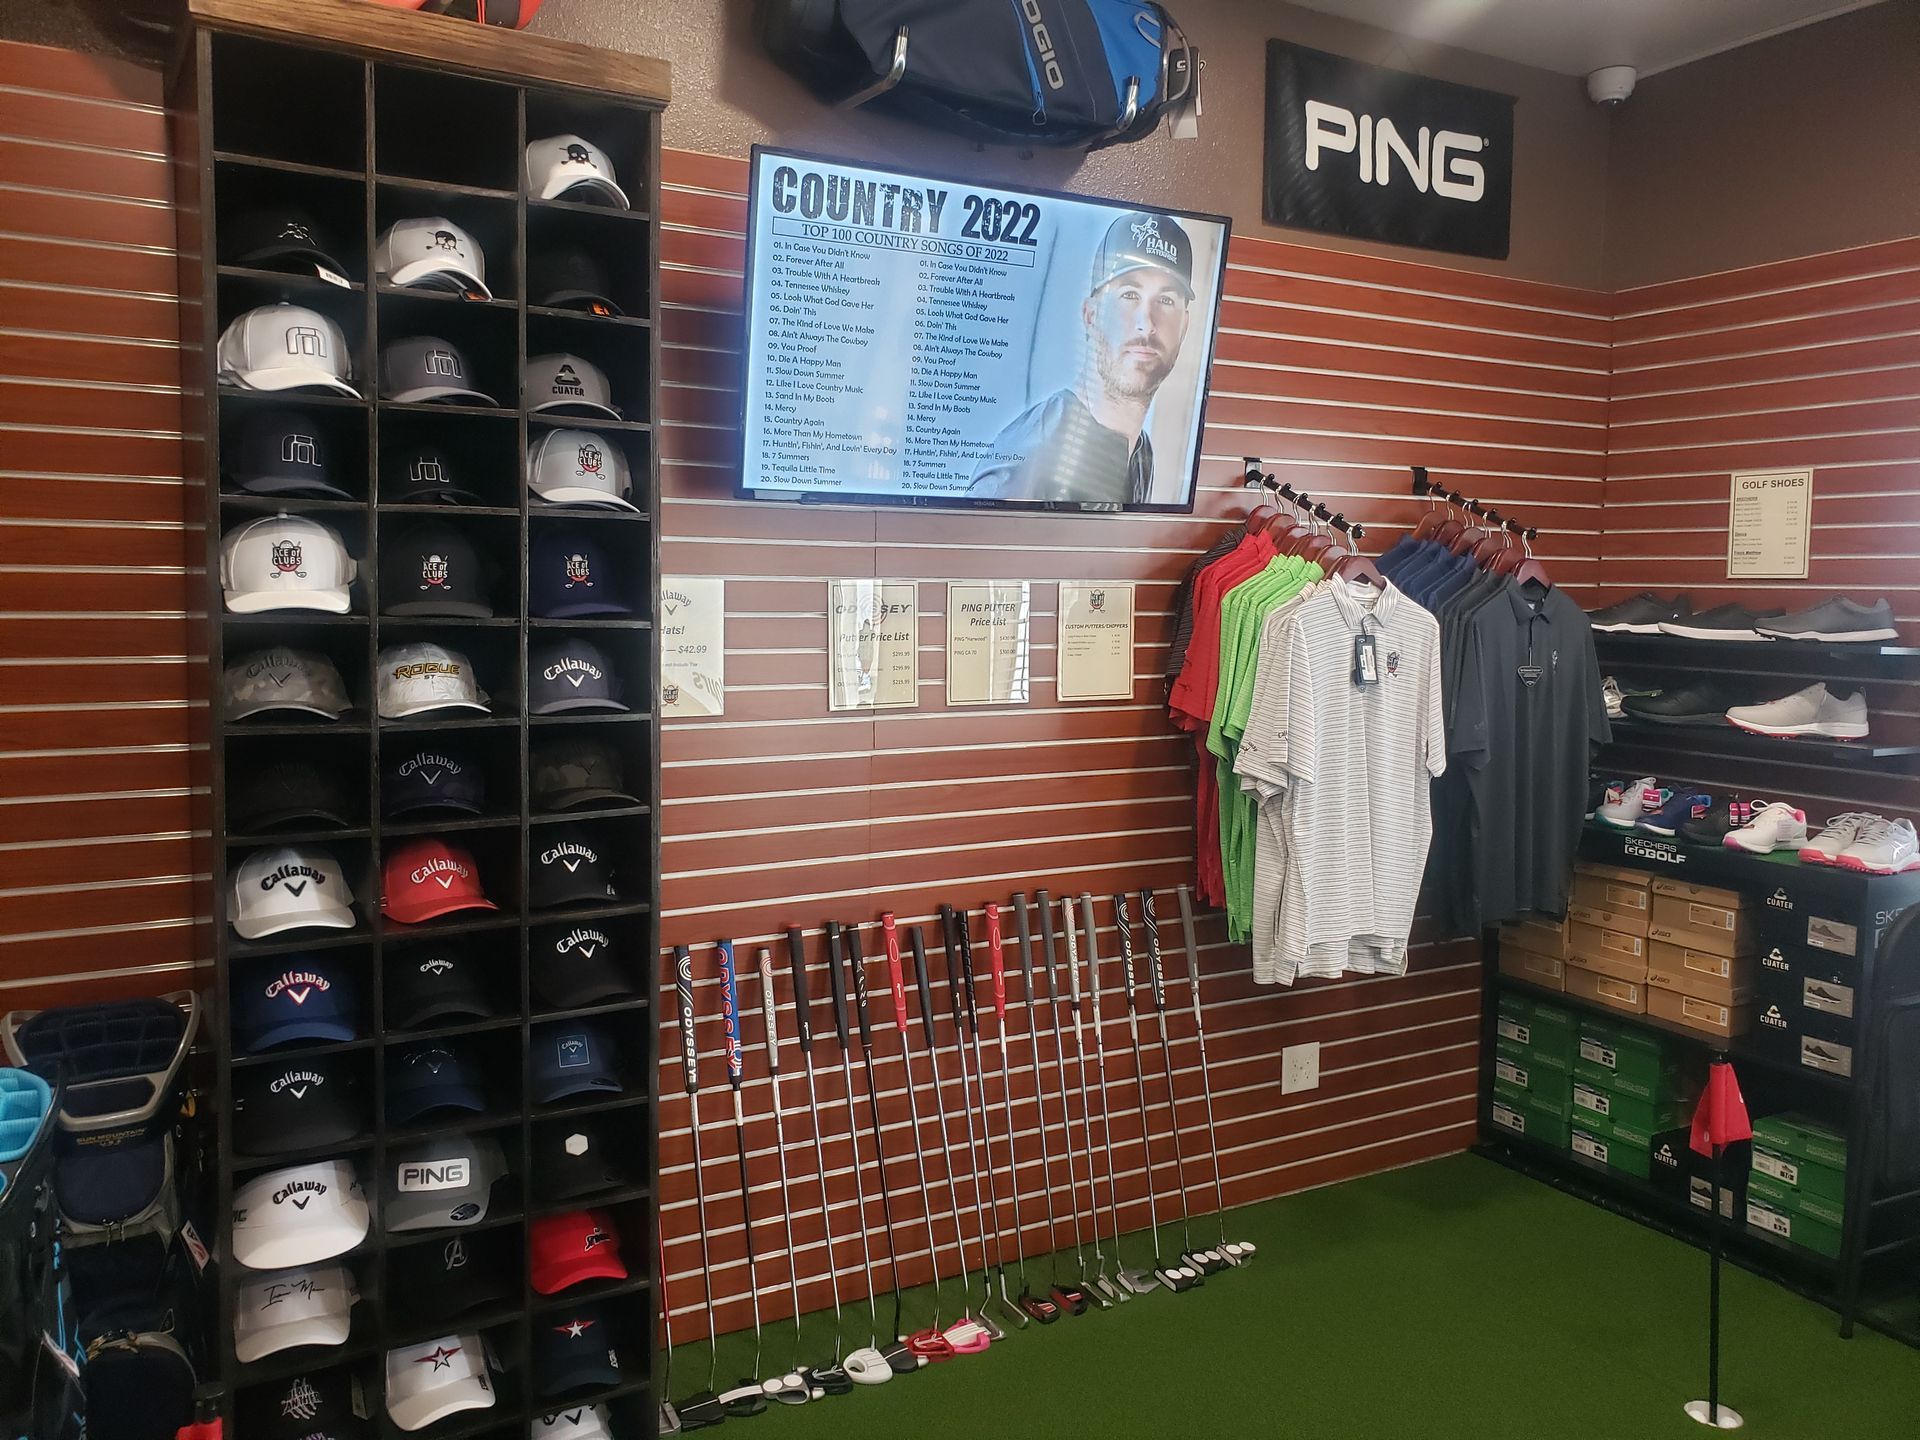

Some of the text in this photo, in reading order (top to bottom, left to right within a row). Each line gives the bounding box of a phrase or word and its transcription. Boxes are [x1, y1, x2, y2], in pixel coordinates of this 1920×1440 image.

[1022, 0, 1064, 90] OGIO
[1305, 100, 1485, 201] PING
[773, 166, 1041, 246] COUNTRY 2022
[784, 241, 792, 250] In
[793, 243, 810, 252] Case
[812, 245, 826, 254] You
[827, 247, 849, 257] Didn't
[850, 250, 870, 260] Know
[802, 223, 1009, 262] TOP 100 COUNTRY SONGS OF 2022
[786, 254, 813, 265] Forever
[814, 258, 833, 267] After
[834, 261, 844, 269] All
[785, 267, 812, 278] Trouble
[813, 271, 831, 280] With
[831, 273, 838, 282] A
[840, 274, 880, 285] Heartbreak
[785, 280, 819, 291] Tennessee
[821, 284, 850, 296] Whiskey
[783, 292, 802, 302] Look
[803, 295, 823, 304] What
[824, 297, 840, 306] God
[841, 299, 859, 308] Gave
[861, 301, 874, 310] Her
[783, 305, 802, 314] Doin'
[803, 307, 816, 316] This
[781, 317, 795, 326] The
[796, 319, 813, 328] Kind
[814, 321, 822, 329] of
[823, 322, 840, 331] Love
[841, 324, 854, 332] We
[855, 325, 874, 334] Make
[781, 330, 798, 339] Ain't
[799, 332, 824, 342] Always
[826, 334, 839, 343] The
[840, 336, 868, 347] Cowboy
[780, 342, 796, 351] You
[797, 344, 817, 353] Proof
[778, 354, 790, 363] Die
[791, 356, 798, 364] A
[799, 356, 824, 367] Happy
[825, 359, 841, 367] Man
[775, 367, 792, 375] Slow
[793, 368, 814, 377] Down
[816, 370, 844, 380] Summer
[552, 386, 584, 397] CUATER
[776, 379, 792, 388] Like
[793, 380, 796, 388] I
[797, 381, 814, 390] Love
[815, 382, 843, 393] Country
[844, 385, 863, 393] Music
[775, 391, 794, 400] Sand
[795, 392, 802, 401] In
[803, 393, 814, 403] My
[815, 394, 835, 403] Boots
[775, 404, 796, 413] Mercy
[774, 415, 803, 426] Country
[803, 418, 824, 427] Again
[1742, 478, 1805, 490] GOLF SHOES
[273, 548, 289, 557] ACE
[273, 557, 301, 565] CLUBS
[423, 562, 438, 571] ACE
[566, 569, 590, 577] CLUBS
[567, 561, 580, 570] ACE
[422, 571, 448, 579] CLUBS
[961, 603, 1016, 613] PING PUTTER
[970, 617, 1007, 627] Price List
[870, 632, 892, 643] Price
[894, 631, 910, 642] List
[678, 645, 707, 655] $42.99
[393, 662, 461, 680] ROGUE
[543, 656, 602, 682] Callaway
[399, 752, 462, 778] Callaway
[1625, 836, 1677, 853] SKECHERS
[541, 841, 598, 866] Callaway
[261, 864, 326, 893] Callaway
[411, 856, 469, 885] Callaway
[1766, 897, 1793, 911] CUATER
[556, 928, 609, 954] Callaway
[420, 957, 454, 974] Callaway
[1070, 935, 1080, 984] ODYSSEY
[1125, 940, 1136, 993] ODYSSEY
[1153, 937, 1165, 996] ODYSSEY
[1762, 958, 1790, 971] CUATER
[265, 970, 331, 998] Callaway
[859, 975, 867, 1008] PING
[765, 990, 778, 1046] ODYSSEY
[1760, 1014, 1787, 1029] CUATER
[683, 1006, 697, 1078] ODYSSEY
[270, 1070, 324, 1094] Callaway
[404, 1165, 463, 1186] PING
[272, 1181, 328, 1205] Callaway
